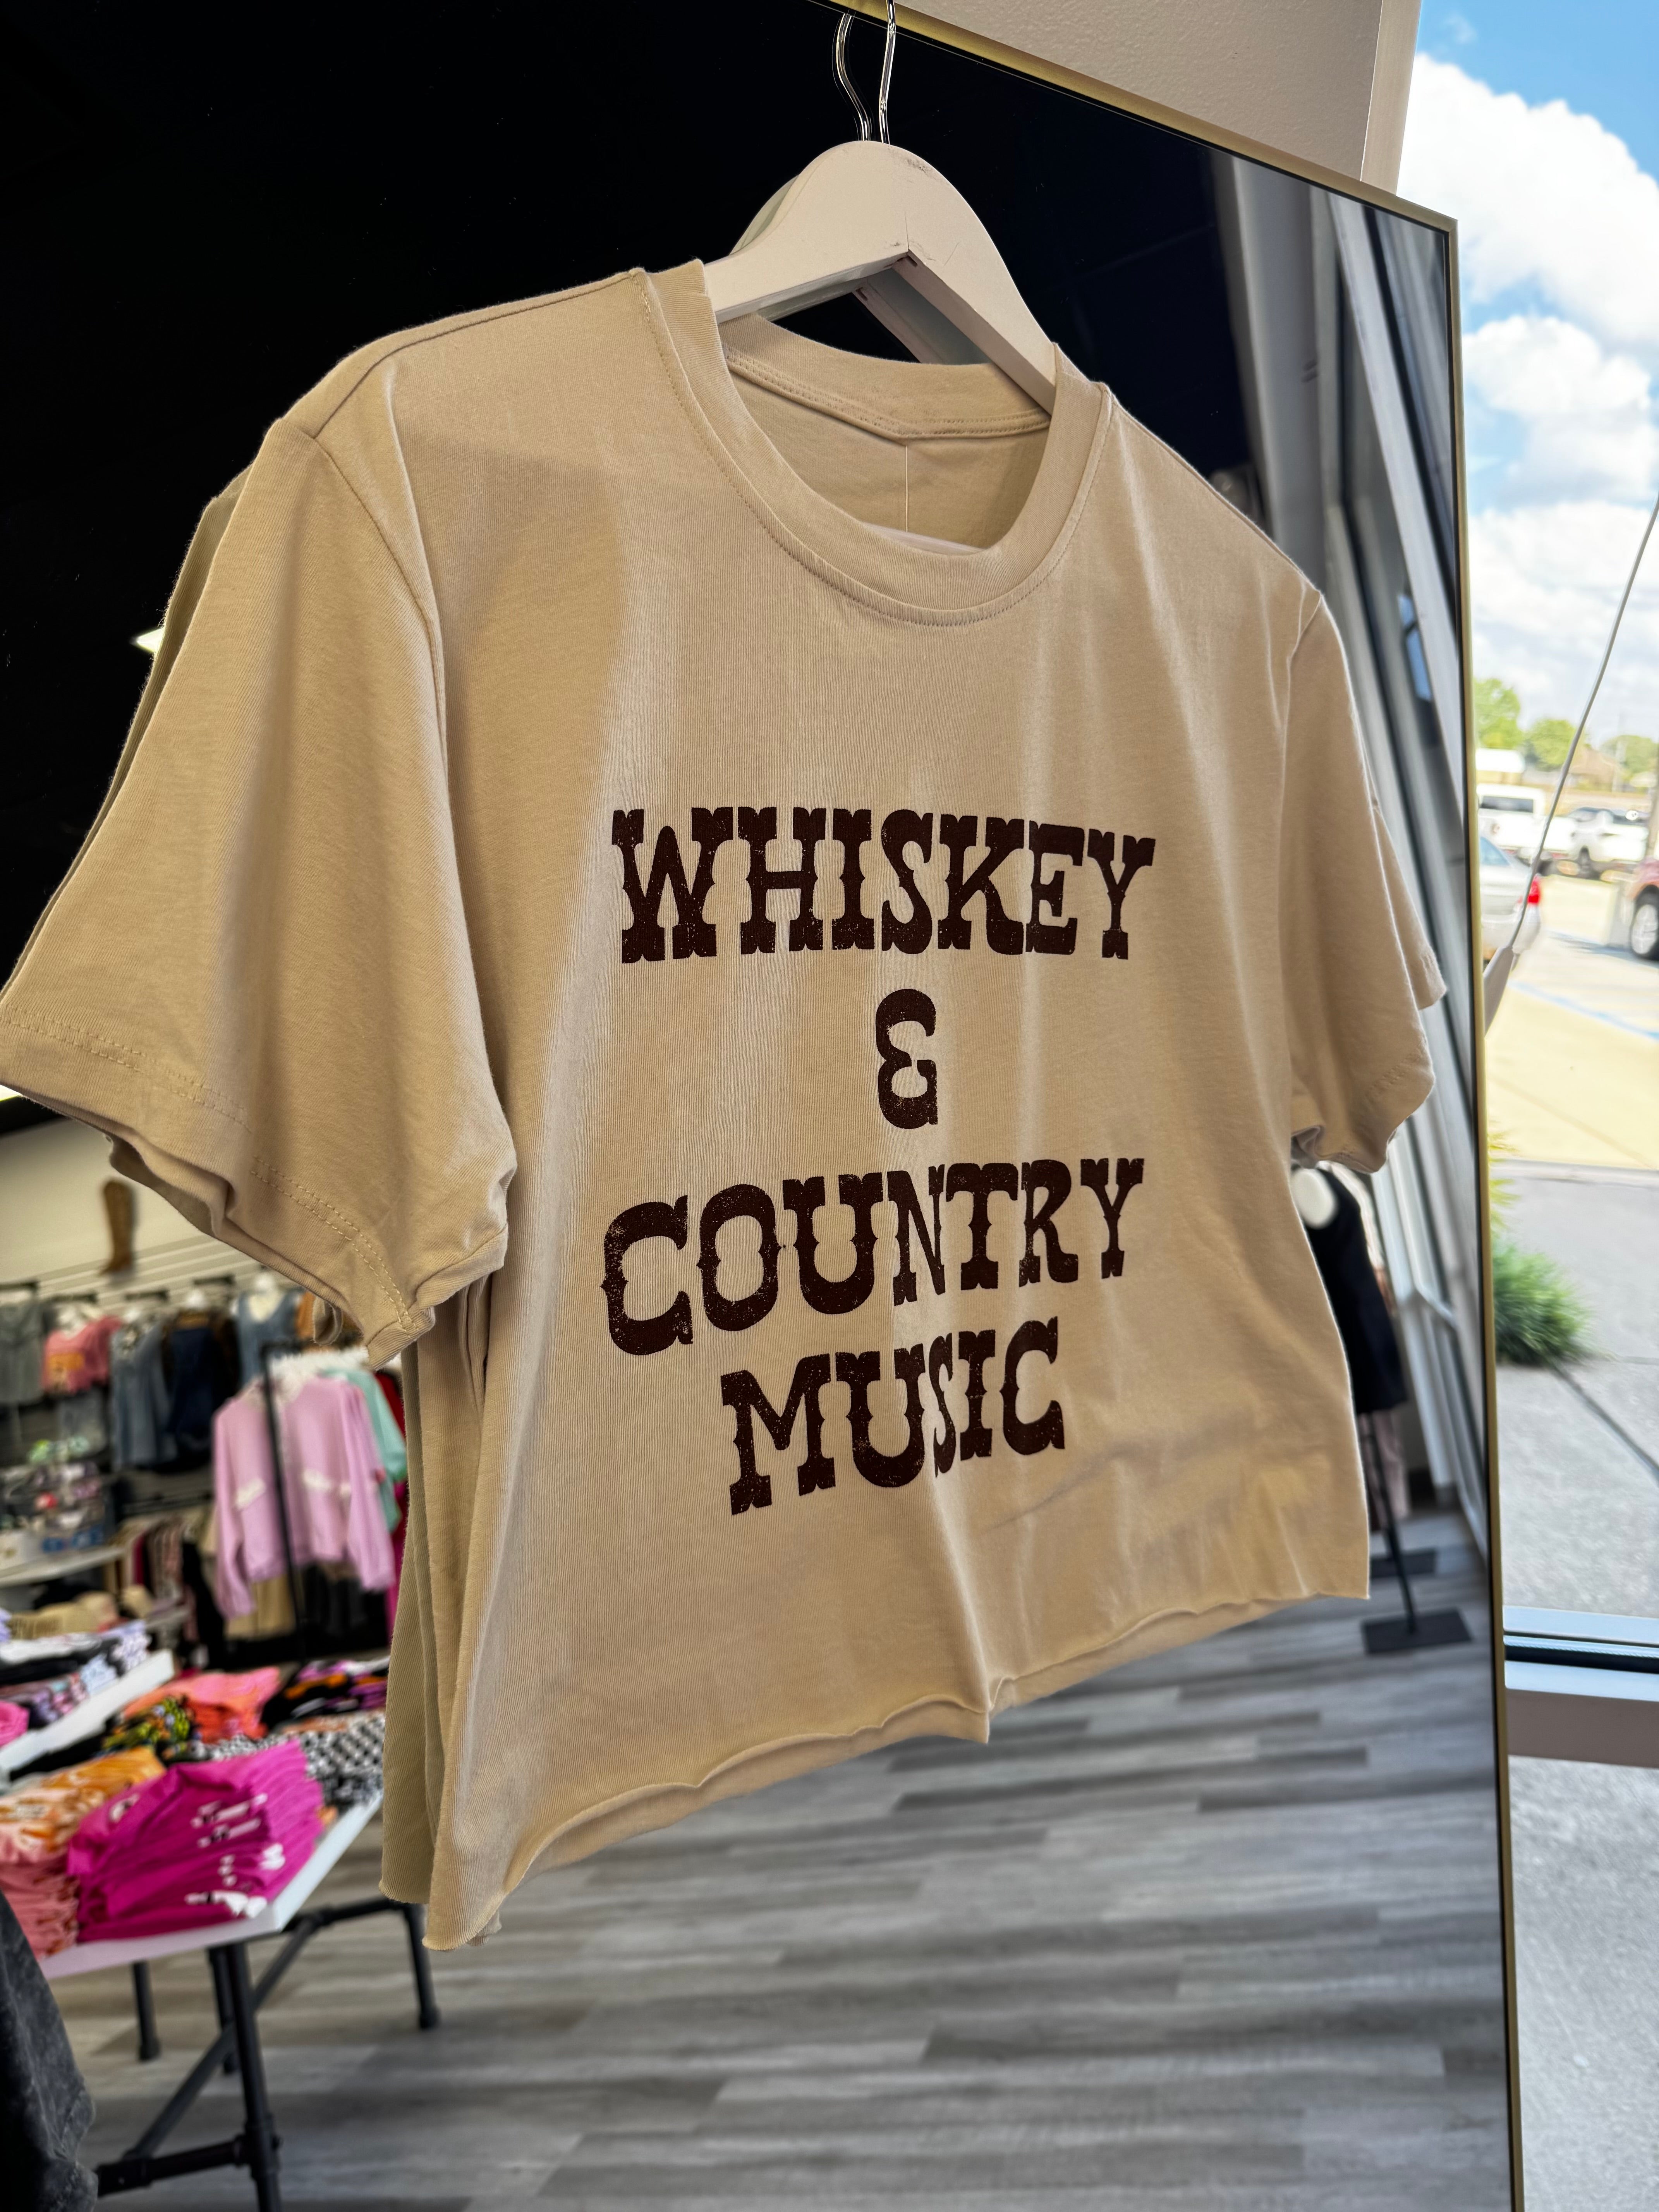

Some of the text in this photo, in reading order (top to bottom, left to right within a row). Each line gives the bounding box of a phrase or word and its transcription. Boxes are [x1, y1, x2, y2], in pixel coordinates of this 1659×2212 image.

[611, 806, 1156, 964] WHISKEY
[875, 989, 938, 1130] &
[600, 1158, 1144, 1356] COUNTRY
[720, 1316, 1065, 1516] MUSIC
